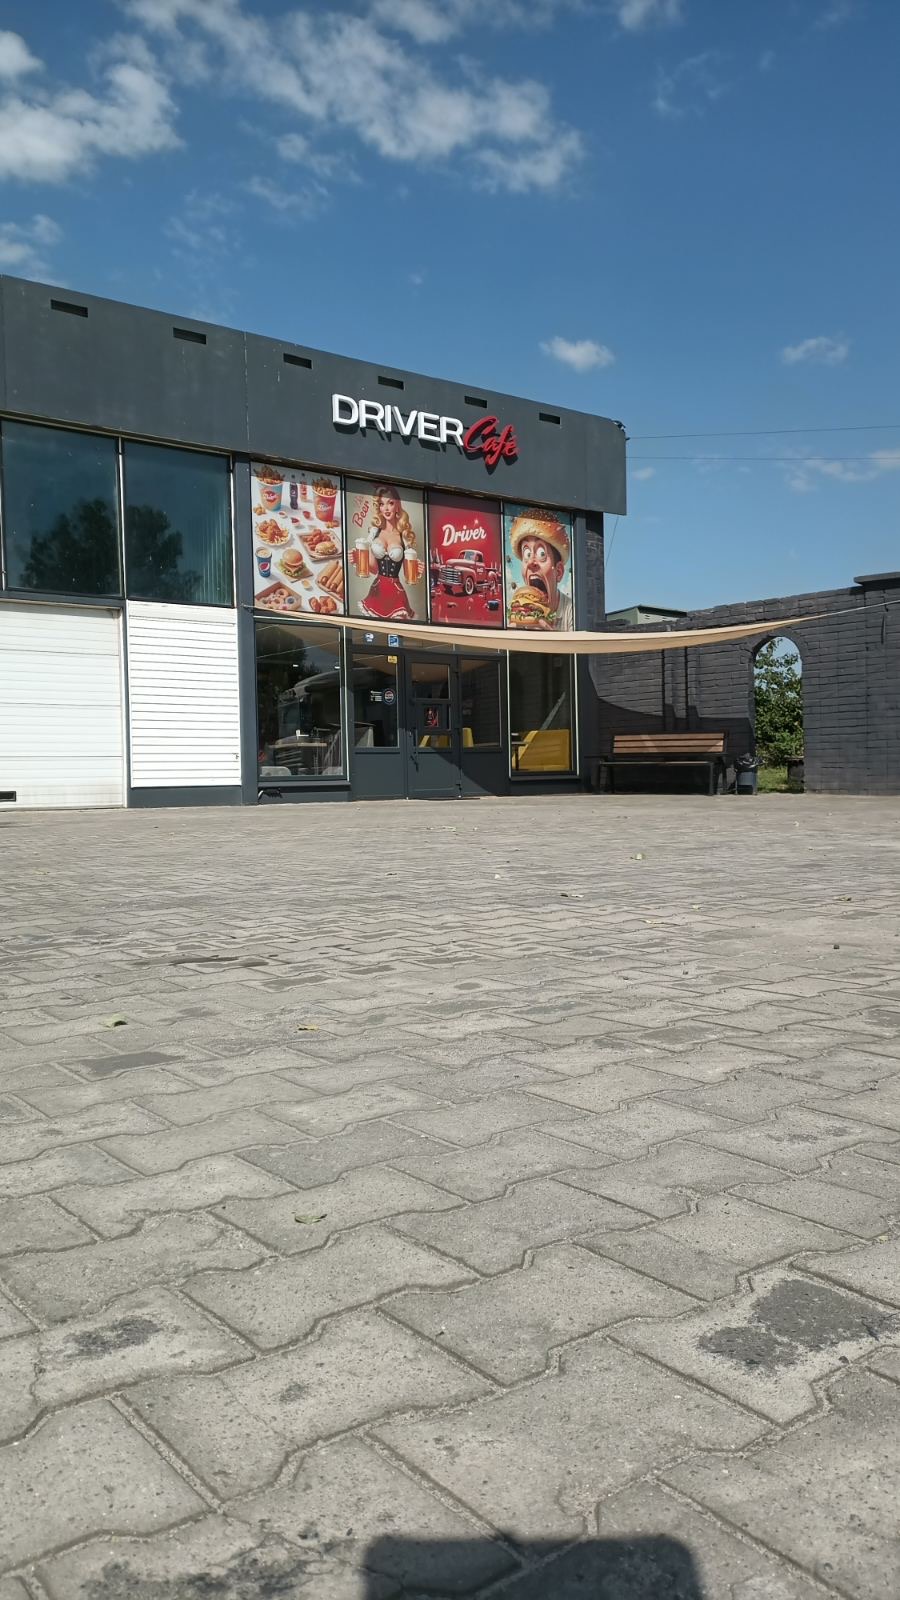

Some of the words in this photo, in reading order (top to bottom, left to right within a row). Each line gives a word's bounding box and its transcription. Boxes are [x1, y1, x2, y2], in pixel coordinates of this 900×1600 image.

[332, 393, 464, 446] DRIVER
[352, 500, 370, 528] Beer
[441, 523, 487, 547] Driver
